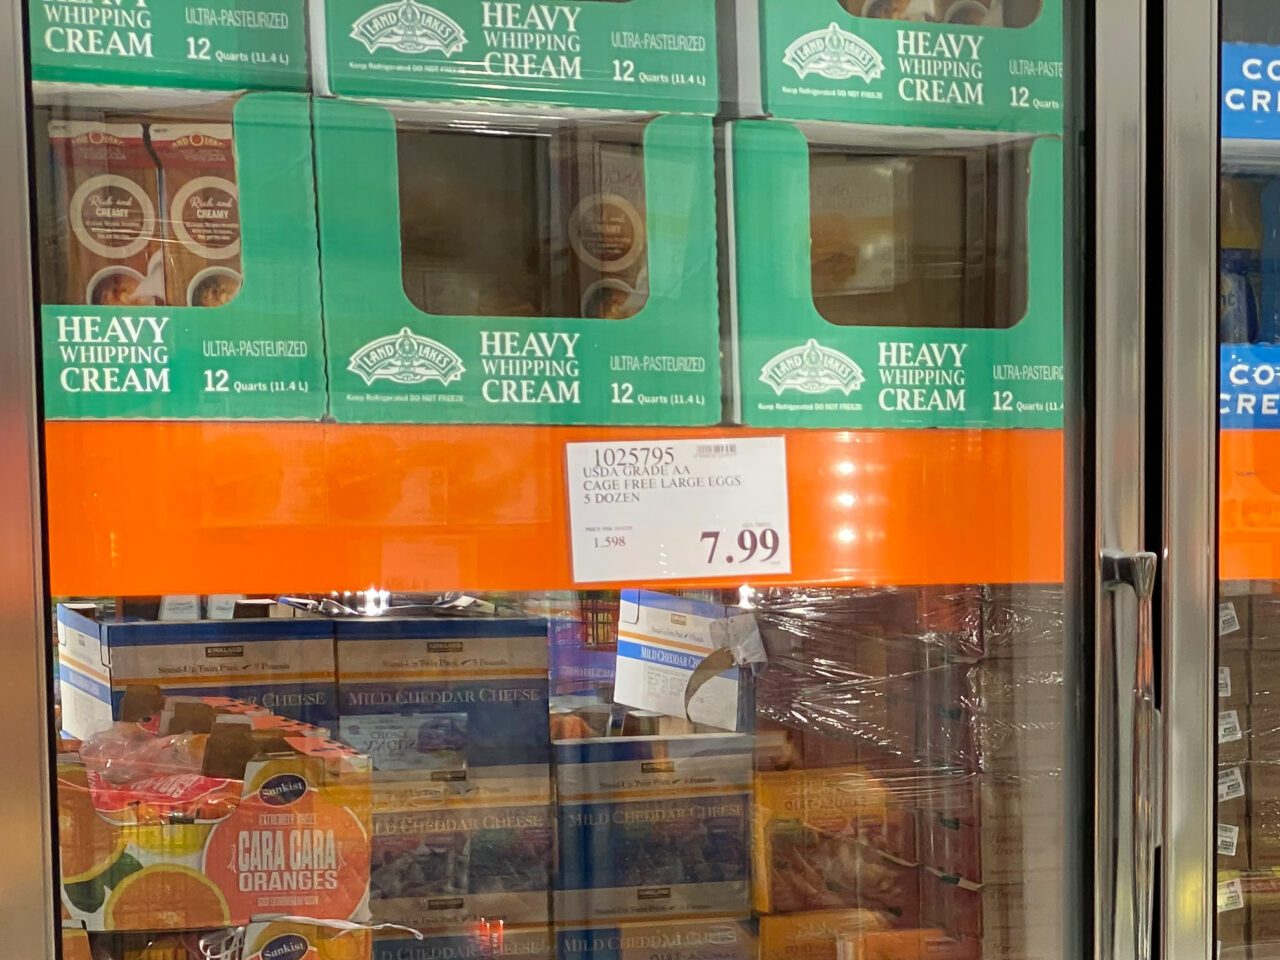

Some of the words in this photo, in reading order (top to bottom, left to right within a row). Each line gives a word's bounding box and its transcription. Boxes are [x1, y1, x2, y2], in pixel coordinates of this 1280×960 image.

[46, 6, 151, 29] WHIPPING
[185, 7, 289, 30] ULTRA-PASTEURIZED
[366, 12, 397, 36] LAND
[420, 13, 453, 38] LAKES
[482, 2, 582, 32] HEAVY
[44, 27, 154, 58] CREAM
[186, 37, 211, 60] 12
[216, 51, 248, 62] Quarts
[483, 31, 580, 52] WHIPPING
[611, 32, 705, 52] ULTRA-PASTEURIZED
[797, 39, 825, 64] LAND
[844, 40, 872, 65] LAKES
[897, 30, 983, 60] HEAVY
[483, 52, 582, 80] CREAM
[613, 60, 634, 82] 12
[639, 72, 668, 83] Quarts
[898, 58, 982, 79] WHIPPING
[898, 79, 984, 105] CREAM
[1010, 87, 1029, 107] 12
[1032, 98, 1060, 110] Quarts
[197, 208, 229, 219] CREAMY
[57, 316, 170, 344] HEAVY
[60, 346, 169, 364] WHIPPING
[203, 340, 307, 357] ULTRA-PASTEURIZED
[480, 331, 580, 358] HEAVY
[878, 342, 967, 367] HEAVY
[363, 345, 394, 369] LAND
[418, 345, 451, 369] LAKES
[482, 358, 579, 376] WHIPPING
[610, 355, 705, 372] ULTRA-PASTEURIZED
[775, 355, 802, 377] LAND
[823, 355, 851, 377] LAKES
[60, 367, 170, 392] CREAM
[204, 370, 229, 392] 12
[234, 381, 267, 393] Quarts
[270, 381, 296, 393] (11.4
[880, 369, 966, 386] WHIPPING
[482, 380, 580, 403] CREAM
[611, 383, 633, 403] 12
[638, 394, 668, 405] Quarts
[878, 388, 966, 411] CREAM
[993, 391, 1013, 411] 12
[1016, 401, 1043, 411] Quarts
[594, 447, 675, 467] 1025795
[583, 467, 618, 478] USDA
[623, 465, 668, 477] GRADE
[672, 465, 690, 475] AA
[583, 480, 619, 491] CAGE
[624, 479, 656, 490] FREE
[661, 477, 704, 488] LARGE
[708, 476, 741, 487] EGGS
[584, 493, 591, 504] 5
[595, 492, 640, 504] DOZEN
[594, 536, 626, 548] 1.598
[700, 528, 780, 564] 7.99
[349, 692, 391, 705] MILD
[396, 689, 475, 704] CHEDDAR
[479, 687, 541, 701] CHEESE
[262, 781, 306, 799] Sunkist
[238, 831, 286, 872] CARA
[289, 830, 336, 870] CARA
[239, 871, 337, 892] ORANGES
[264, 941, 307, 959] Sunkist
